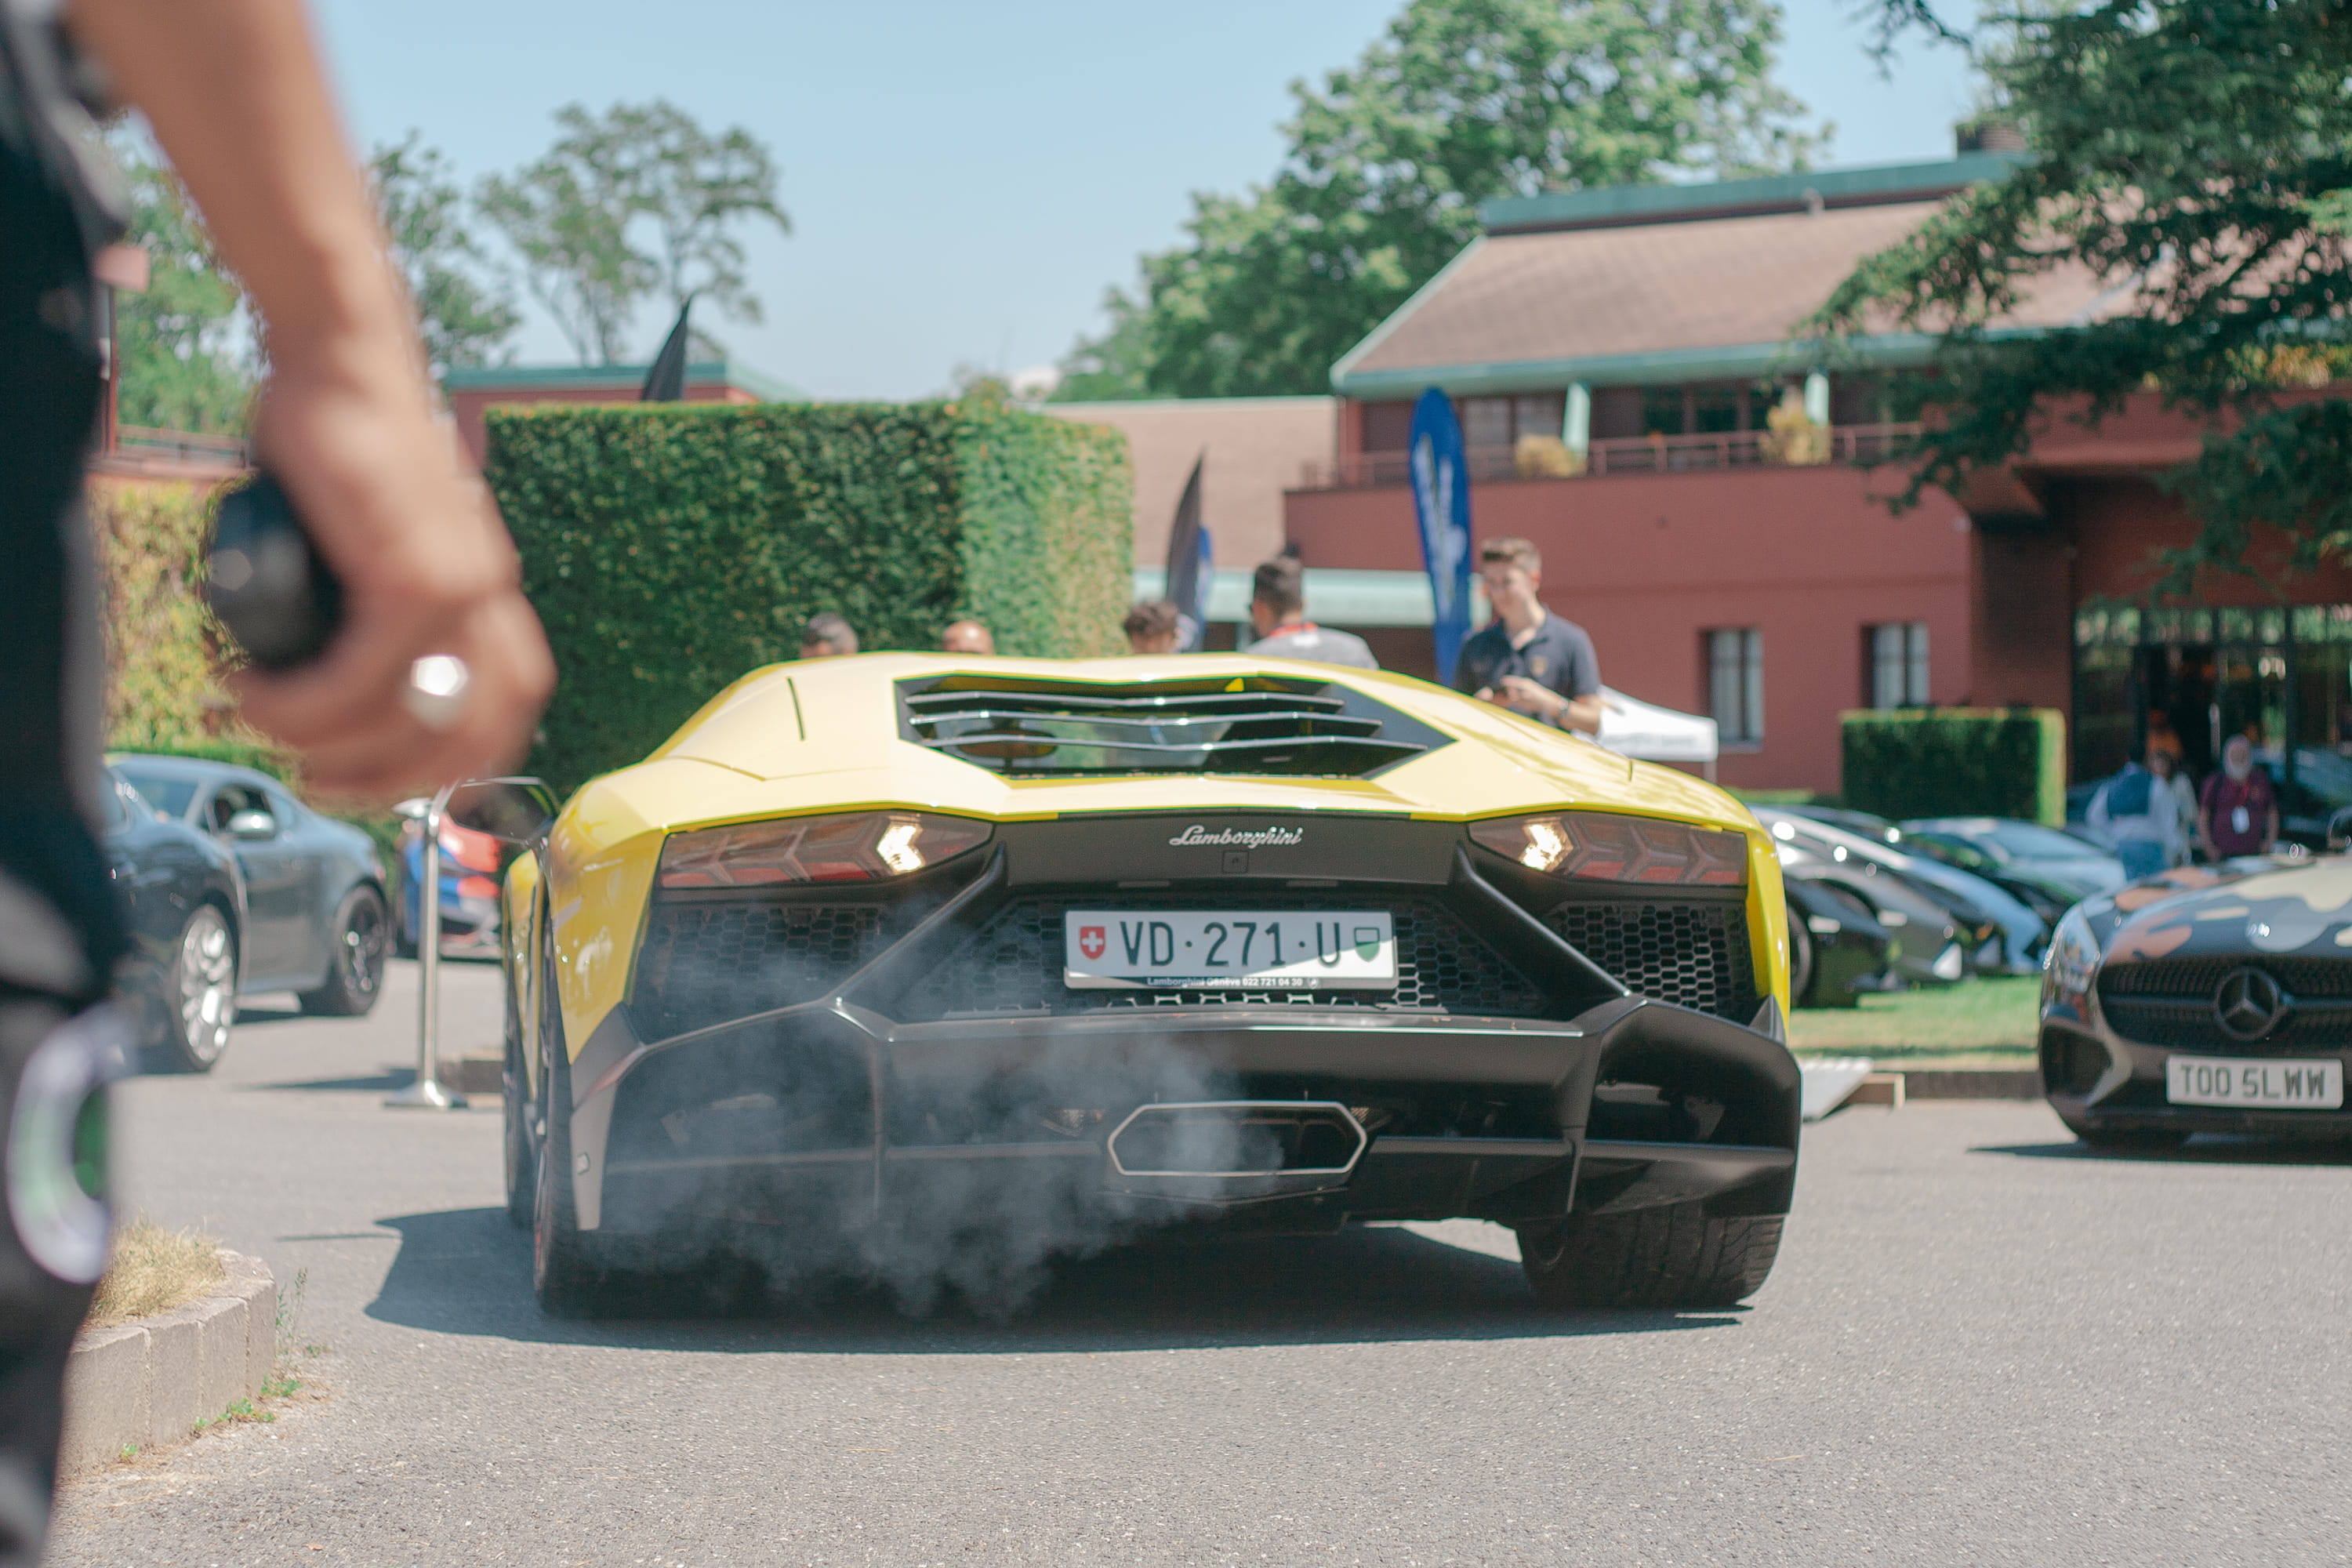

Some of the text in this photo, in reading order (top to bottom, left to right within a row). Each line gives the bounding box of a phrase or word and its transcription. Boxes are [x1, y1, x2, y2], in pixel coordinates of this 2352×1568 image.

[1169, 824, 1303, 849] Lamborghini
[1147, 977, 1205, 989] Lamborghini
[1243, 978, 1258, 987] 022
[1260, 978, 1276, 987] 721
